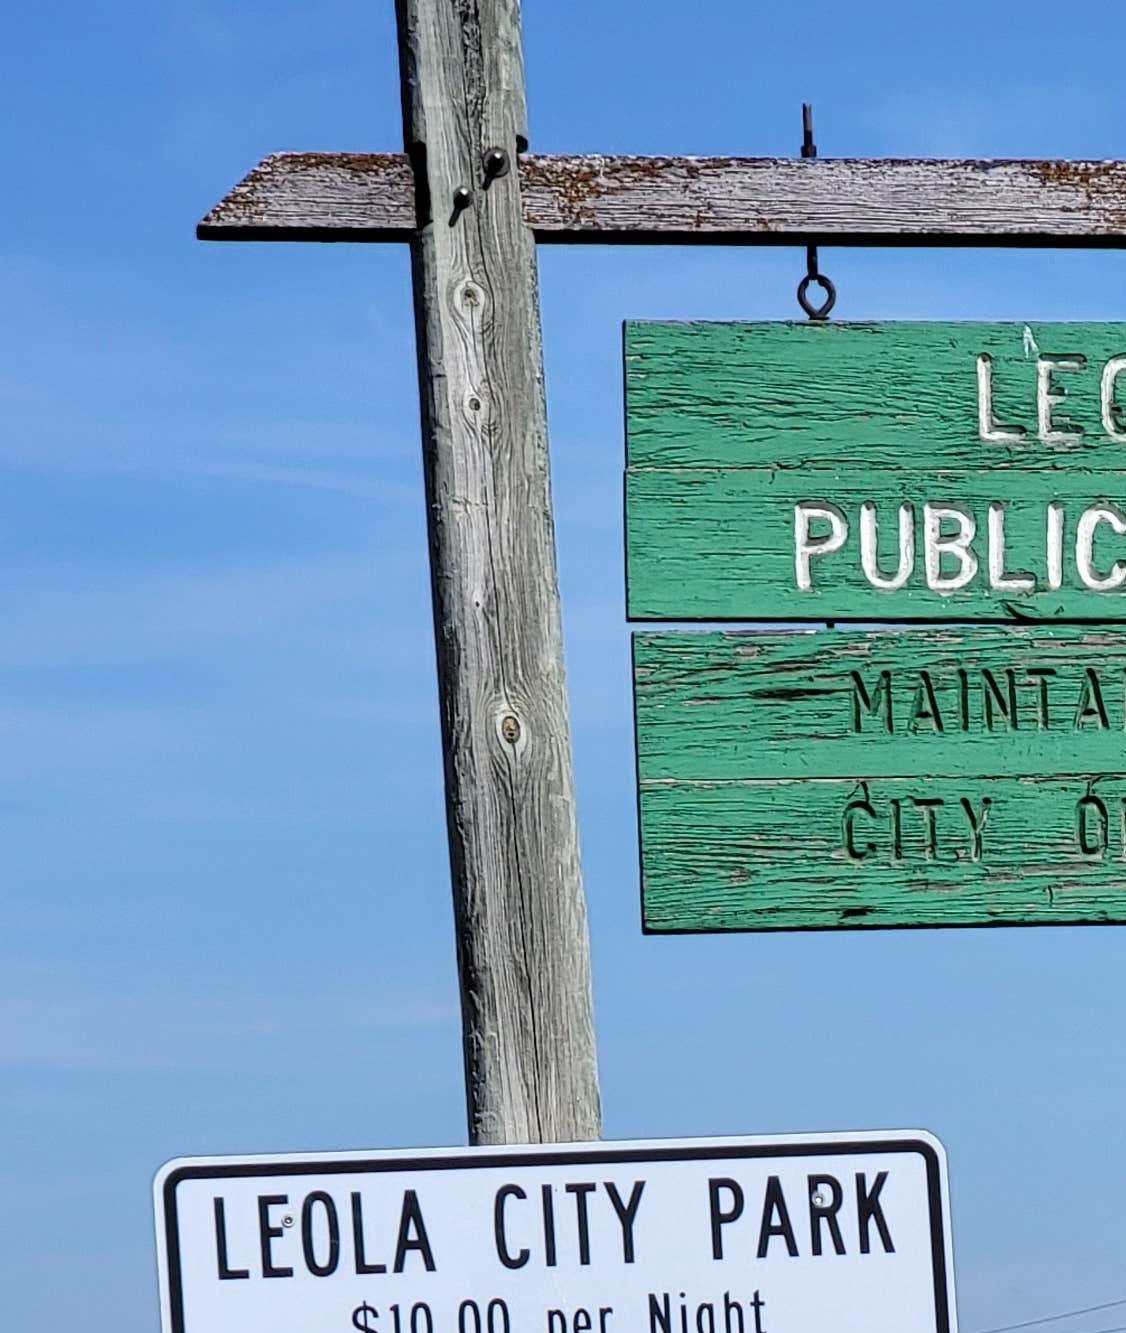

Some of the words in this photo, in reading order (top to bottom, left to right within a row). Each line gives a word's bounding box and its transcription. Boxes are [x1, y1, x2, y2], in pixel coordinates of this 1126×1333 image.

[839, 795, 994, 862] CITY
[214, 1190, 436, 1280] LEOLA
[495, 1181, 645, 1269] CITY
[709, 1172, 895, 1260] PARK
